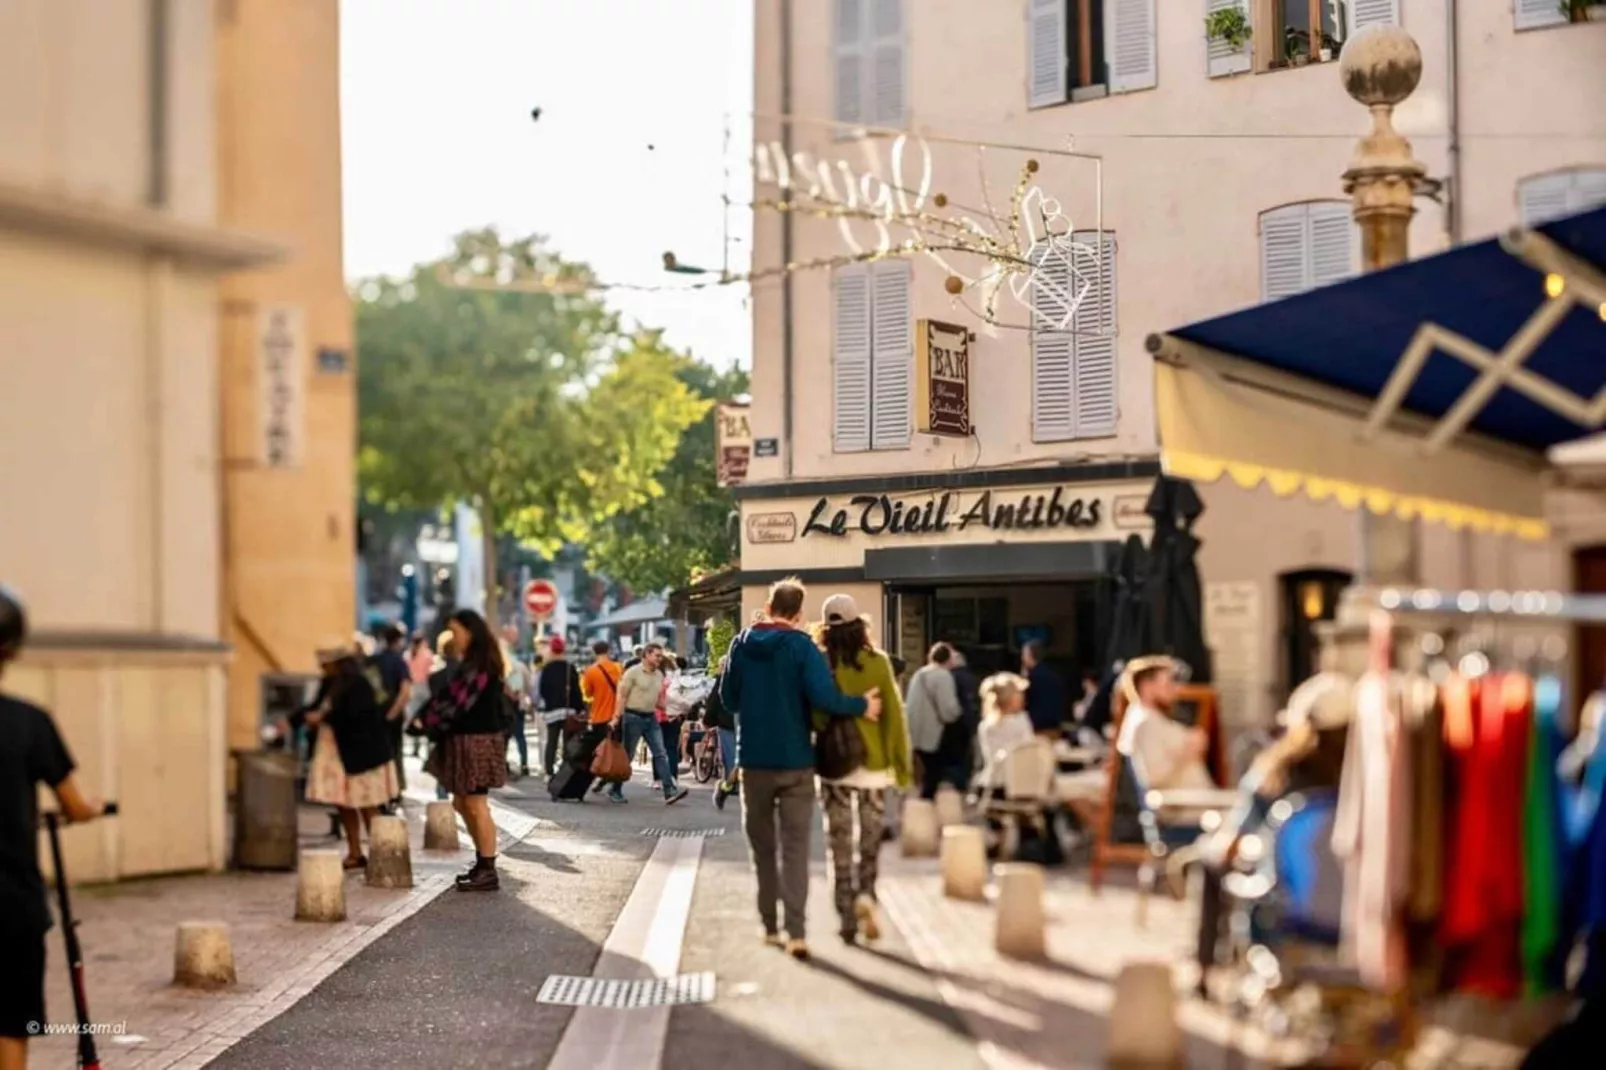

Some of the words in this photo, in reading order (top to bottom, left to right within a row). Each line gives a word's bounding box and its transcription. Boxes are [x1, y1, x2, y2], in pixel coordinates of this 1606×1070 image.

[934, 346, 965, 378] BAR
[801, 497, 847, 537] Le
[850, 493, 951, 535] Vieil
[958, 486, 1101, 531] Antibes
